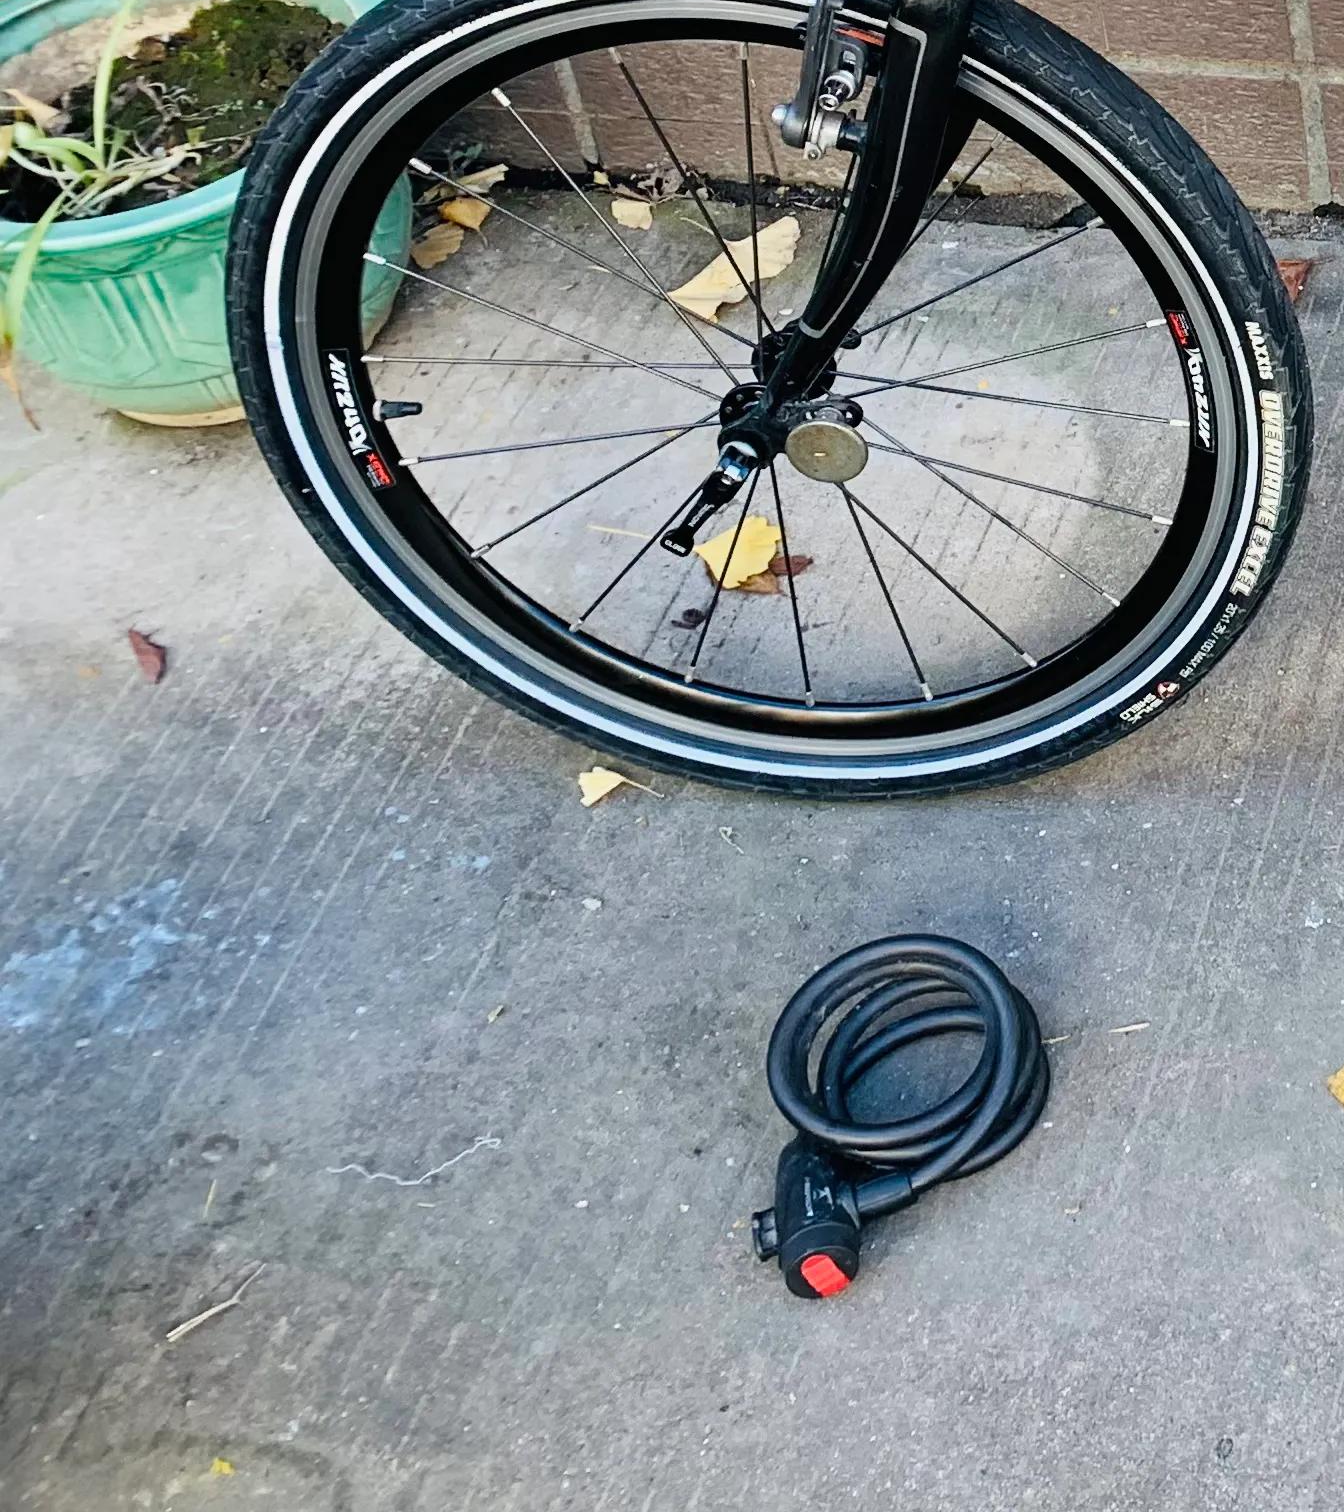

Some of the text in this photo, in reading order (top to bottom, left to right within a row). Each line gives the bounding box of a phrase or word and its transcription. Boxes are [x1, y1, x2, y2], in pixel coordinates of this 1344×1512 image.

[1245, 321, 1274, 380] MAXXIS
[1255, 389, 1285, 531] OVERDRIVE
[1229, 524, 1273, 597] EXCEL
